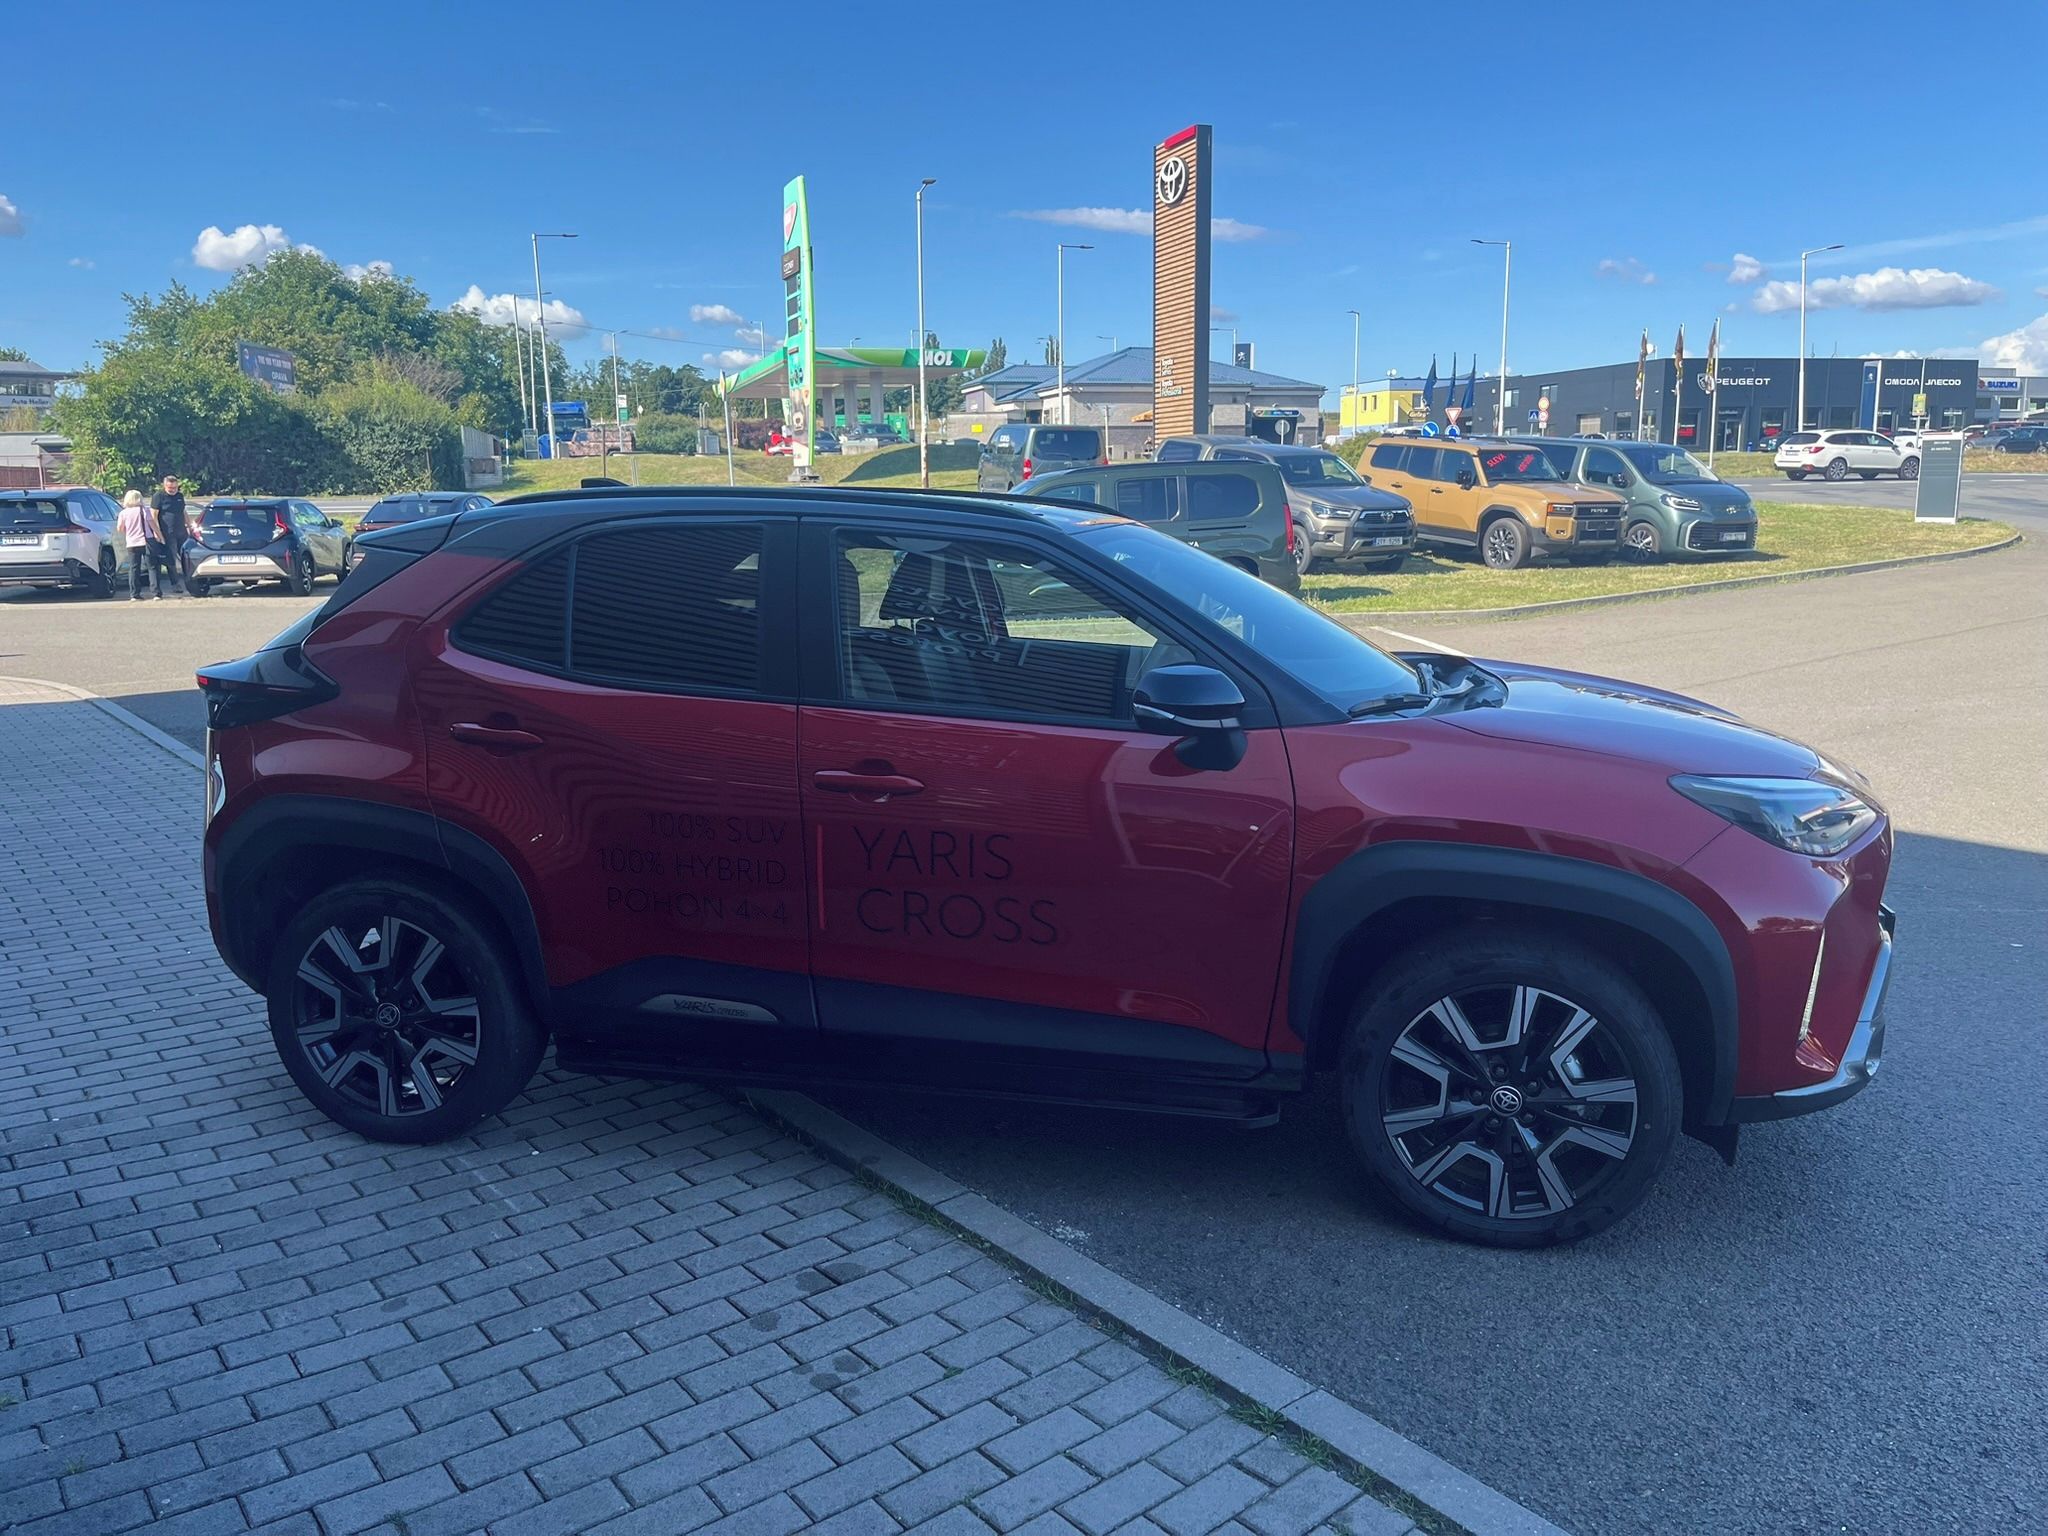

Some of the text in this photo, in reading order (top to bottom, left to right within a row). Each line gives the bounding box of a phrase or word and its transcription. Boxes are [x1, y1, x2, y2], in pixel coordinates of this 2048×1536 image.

[918, 350, 953, 366] MOL
[271, 371, 288, 382] OPAVA
[1715, 378, 1771, 386] PEUGEOT
[1884, 378, 1920, 386] OMODA
[1925, 378, 1962, 386] JAECOO
[1987, 381, 2018, 389] SUZUKI
[648, 812, 787, 845] 100% SUV
[852, 825, 1014, 880] YARIS
[598, 847, 786, 884] 100% HYBRID
[607, 886, 724, 920] POHON
[857, 887, 1059, 945] CROSS
[673, 999, 716, 1014] YARIS
